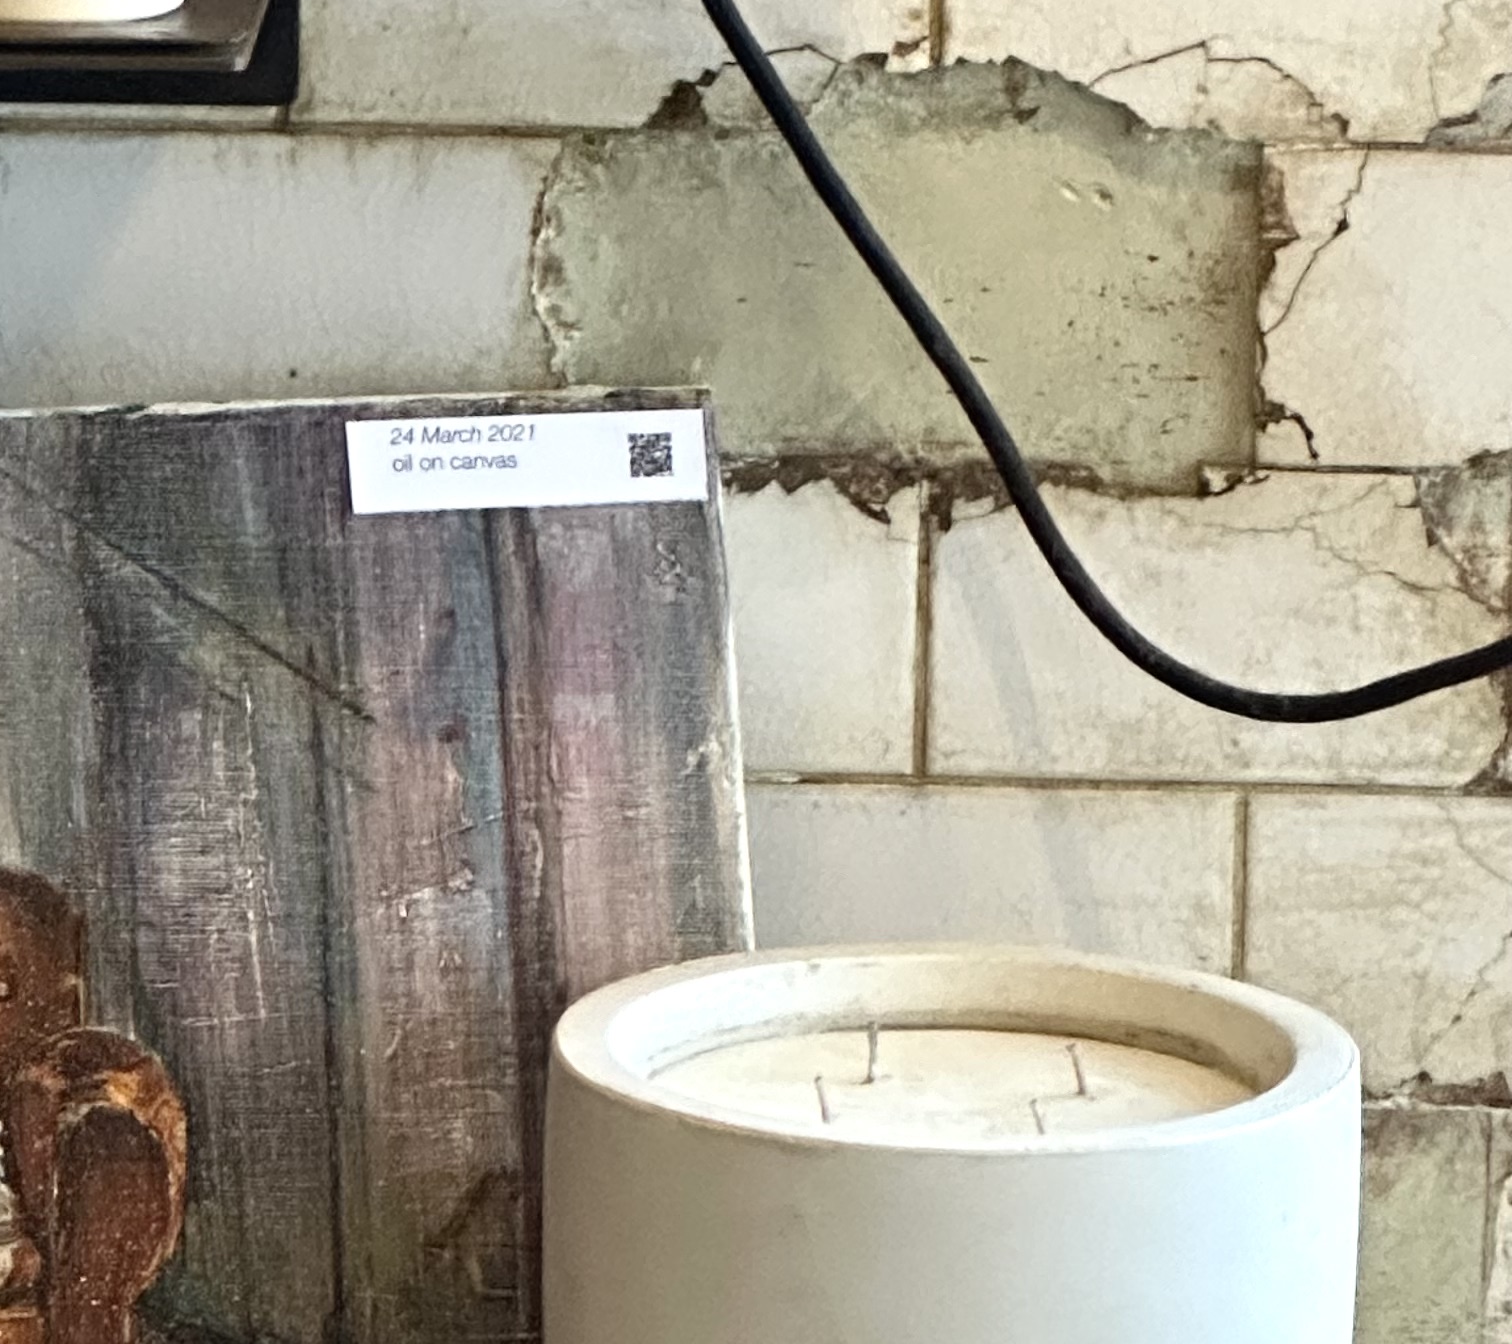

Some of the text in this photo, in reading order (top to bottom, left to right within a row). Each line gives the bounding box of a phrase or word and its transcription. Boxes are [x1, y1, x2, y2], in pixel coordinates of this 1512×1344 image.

[389, 423, 536, 446] 24 March 2021
[392, 453, 519, 473] oil on canvas
